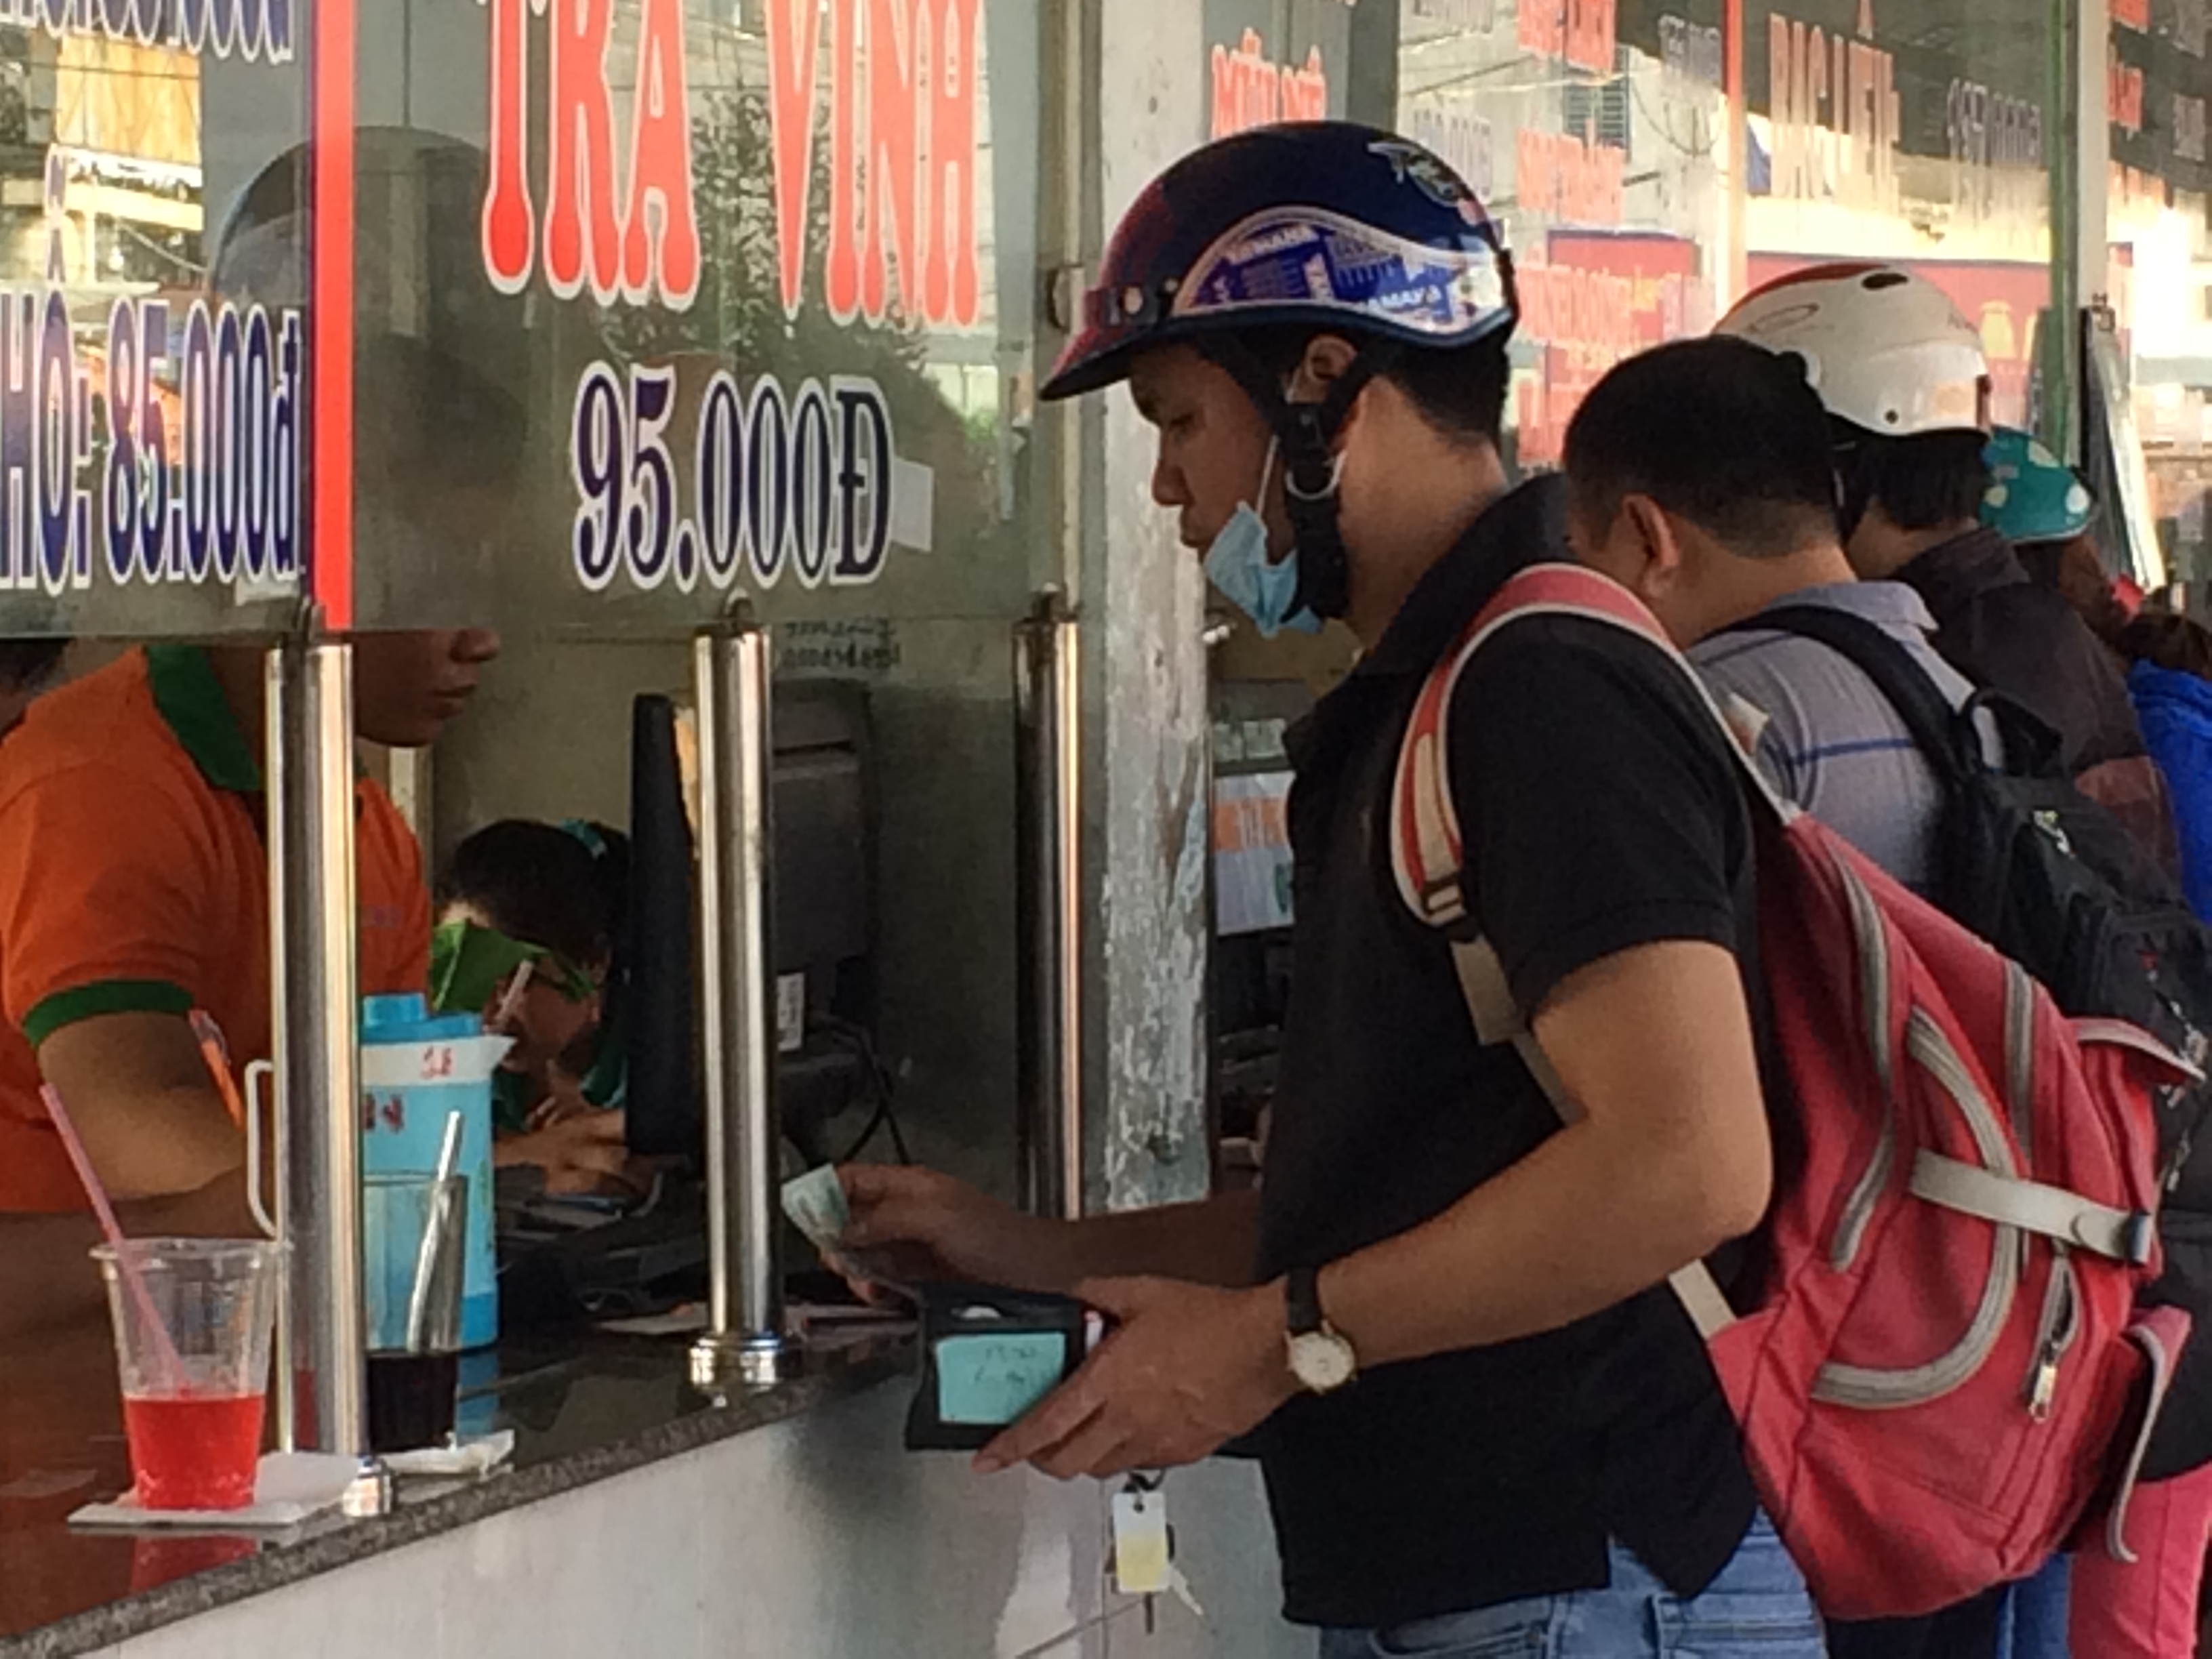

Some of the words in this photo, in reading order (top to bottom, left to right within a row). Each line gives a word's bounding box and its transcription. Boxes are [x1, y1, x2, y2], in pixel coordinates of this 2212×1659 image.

[766, 0, 983, 329] VINH
[103, 298, 302, 584] 85.000đ
[571, 361, 893, 592] 95.000Đ
